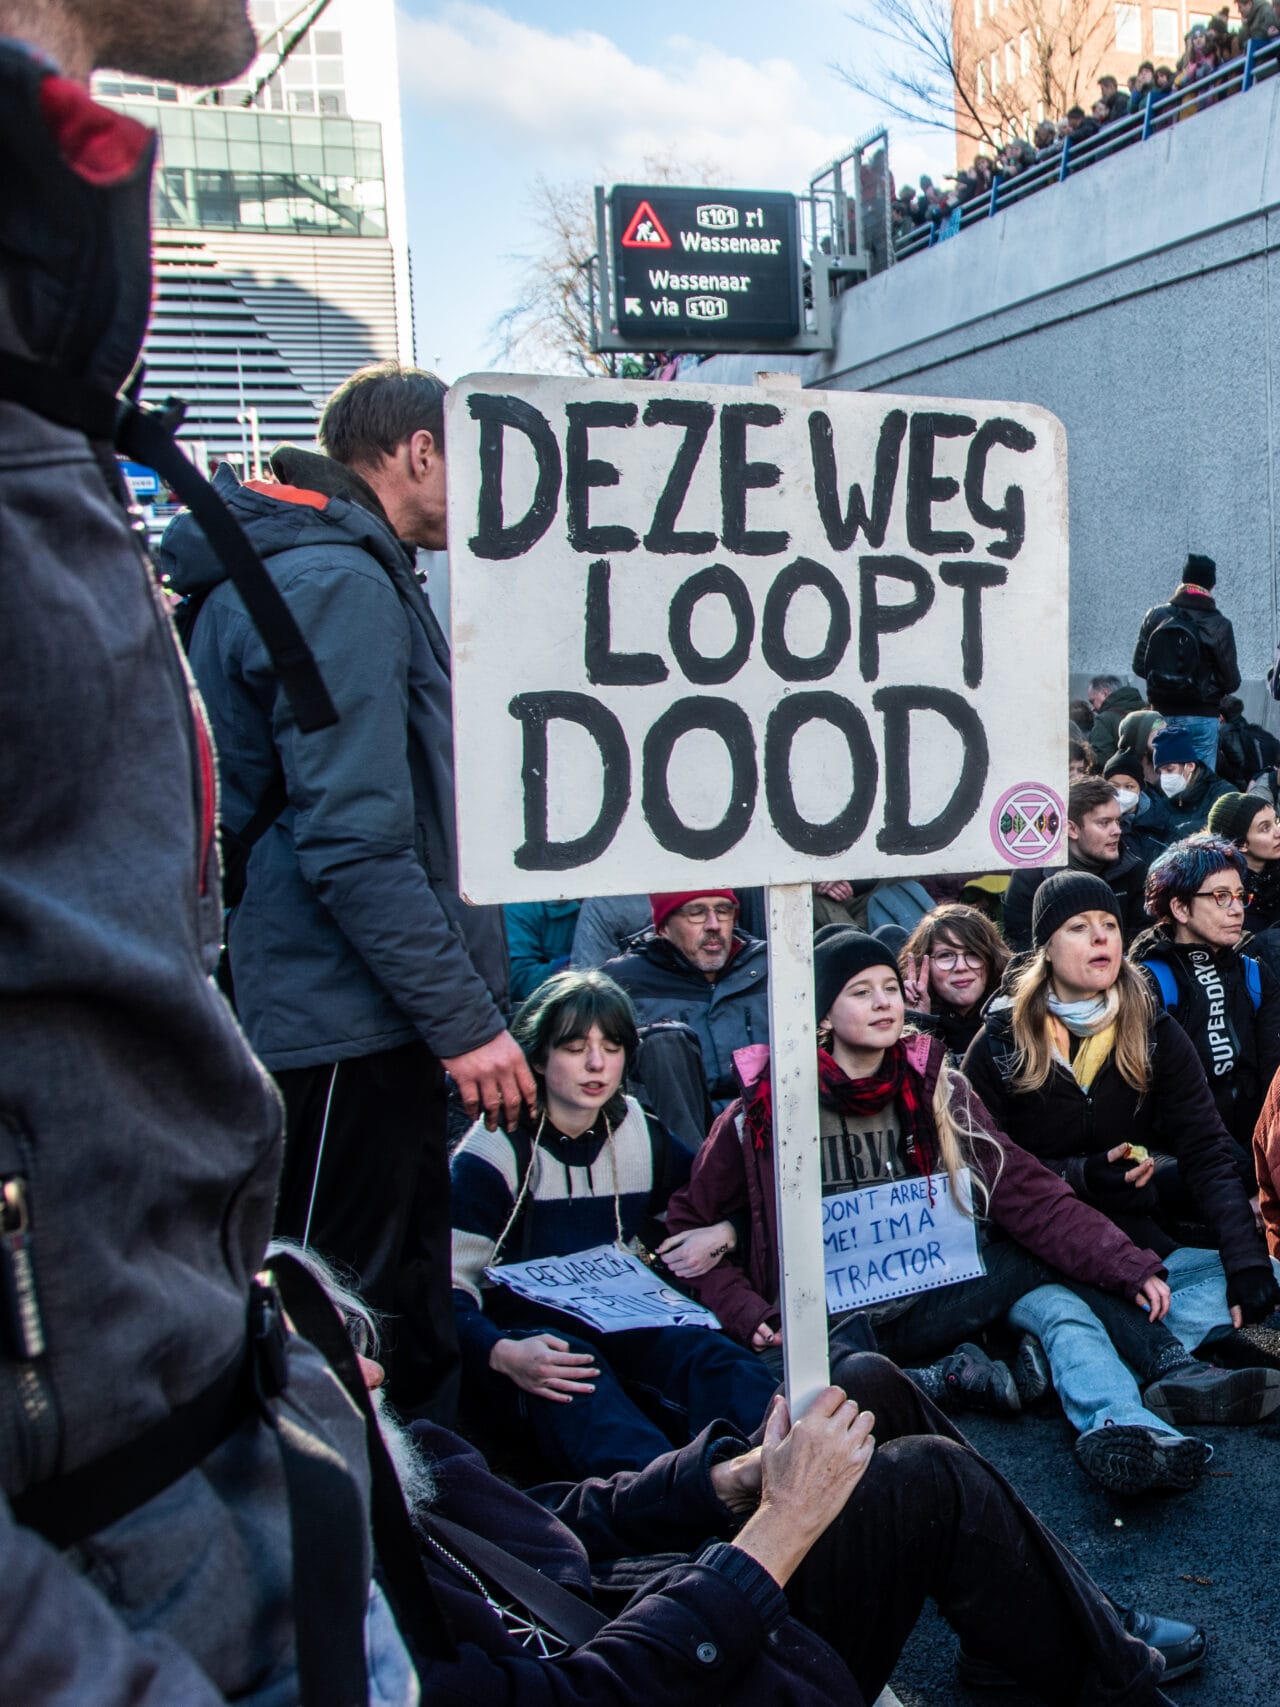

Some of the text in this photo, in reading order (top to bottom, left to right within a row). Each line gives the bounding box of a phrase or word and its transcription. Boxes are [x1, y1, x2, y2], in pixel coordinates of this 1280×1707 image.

[745, 208, 764, 228] ri
[680, 232, 782, 255] Wassenaar
[649, 269, 751, 292] Wassenaar
[650, 297, 680, 317] via
[467, 394, 1037, 560] DEZE WEG
[585, 555, 1009, 689] LOOPT
[508, 685, 990, 871] DOOD
[890, 1175, 950, 1207] ARREST
[822, 1207, 936, 1253] ME! I'M A
[826, 1240, 947, 1298] TRACTOR
[580, 1286, 605, 1296] OF
